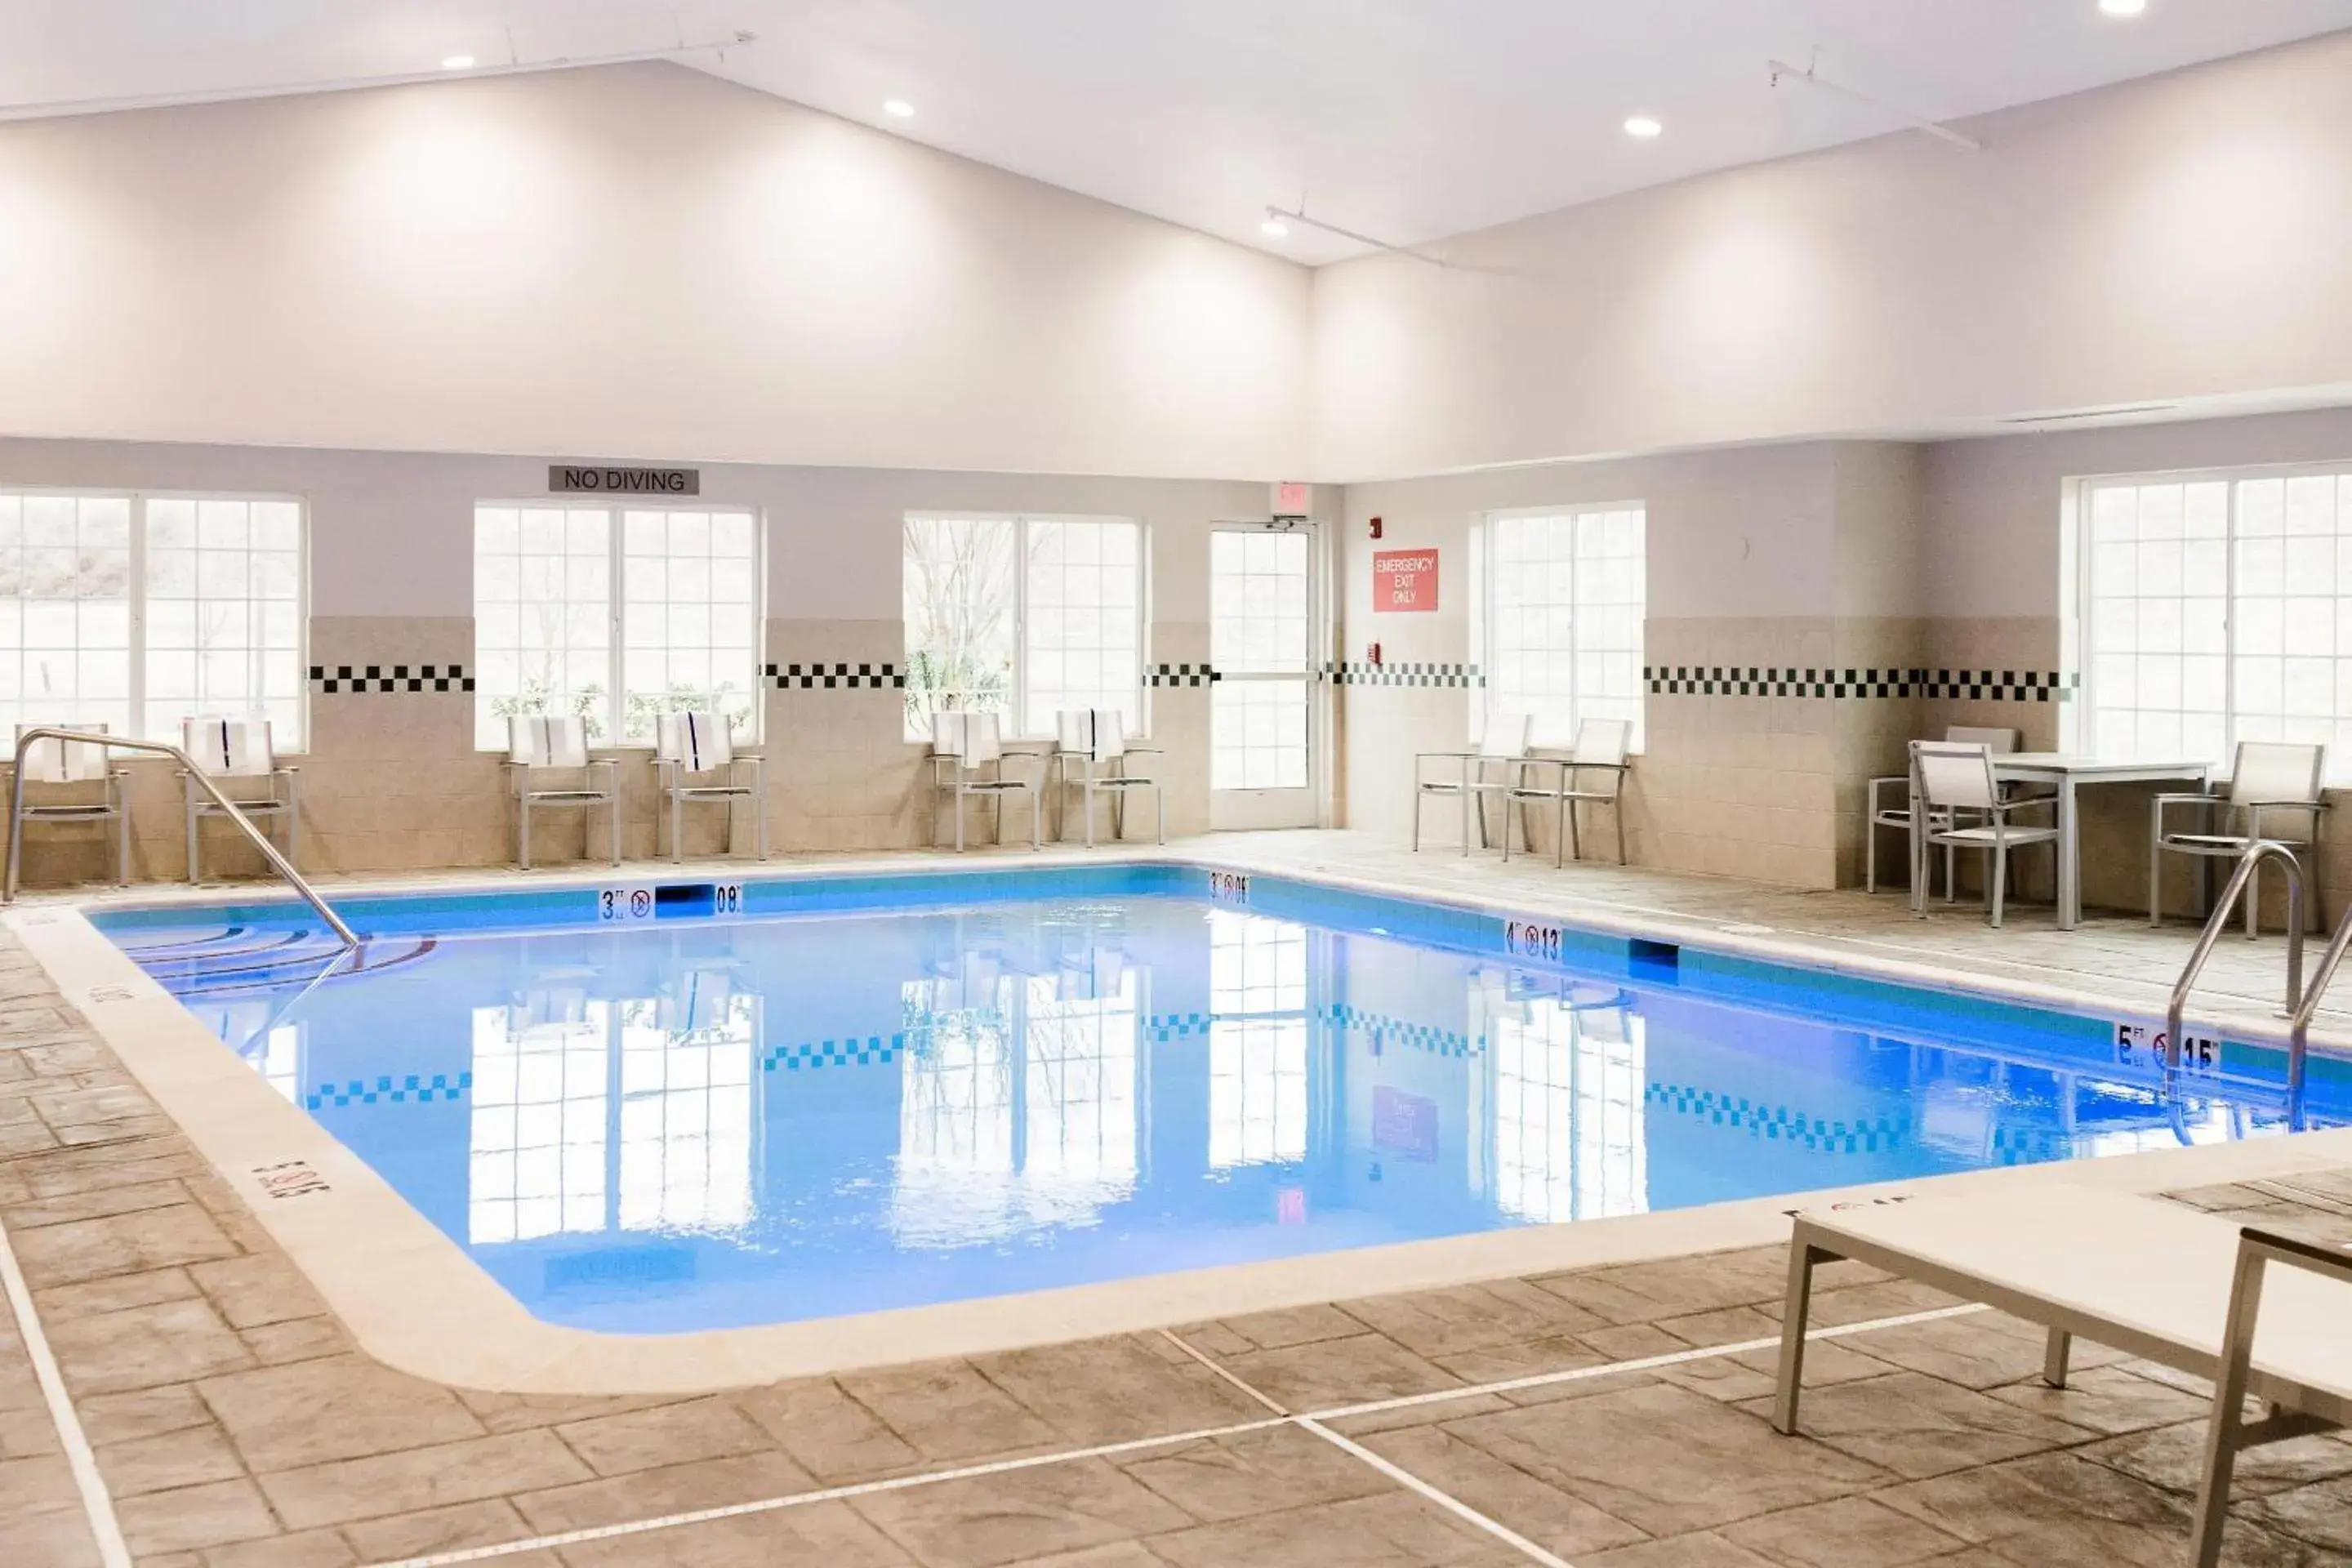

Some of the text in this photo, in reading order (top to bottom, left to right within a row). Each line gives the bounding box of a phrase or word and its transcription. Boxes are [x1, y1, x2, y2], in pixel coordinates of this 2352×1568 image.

[565, 470, 684, 491] NO DIVING
[1376, 557, 1434, 572] EMERGENCY
[1395, 574, 1414, 588] EXIT
[1393, 590, 1416, 604] ONLY
